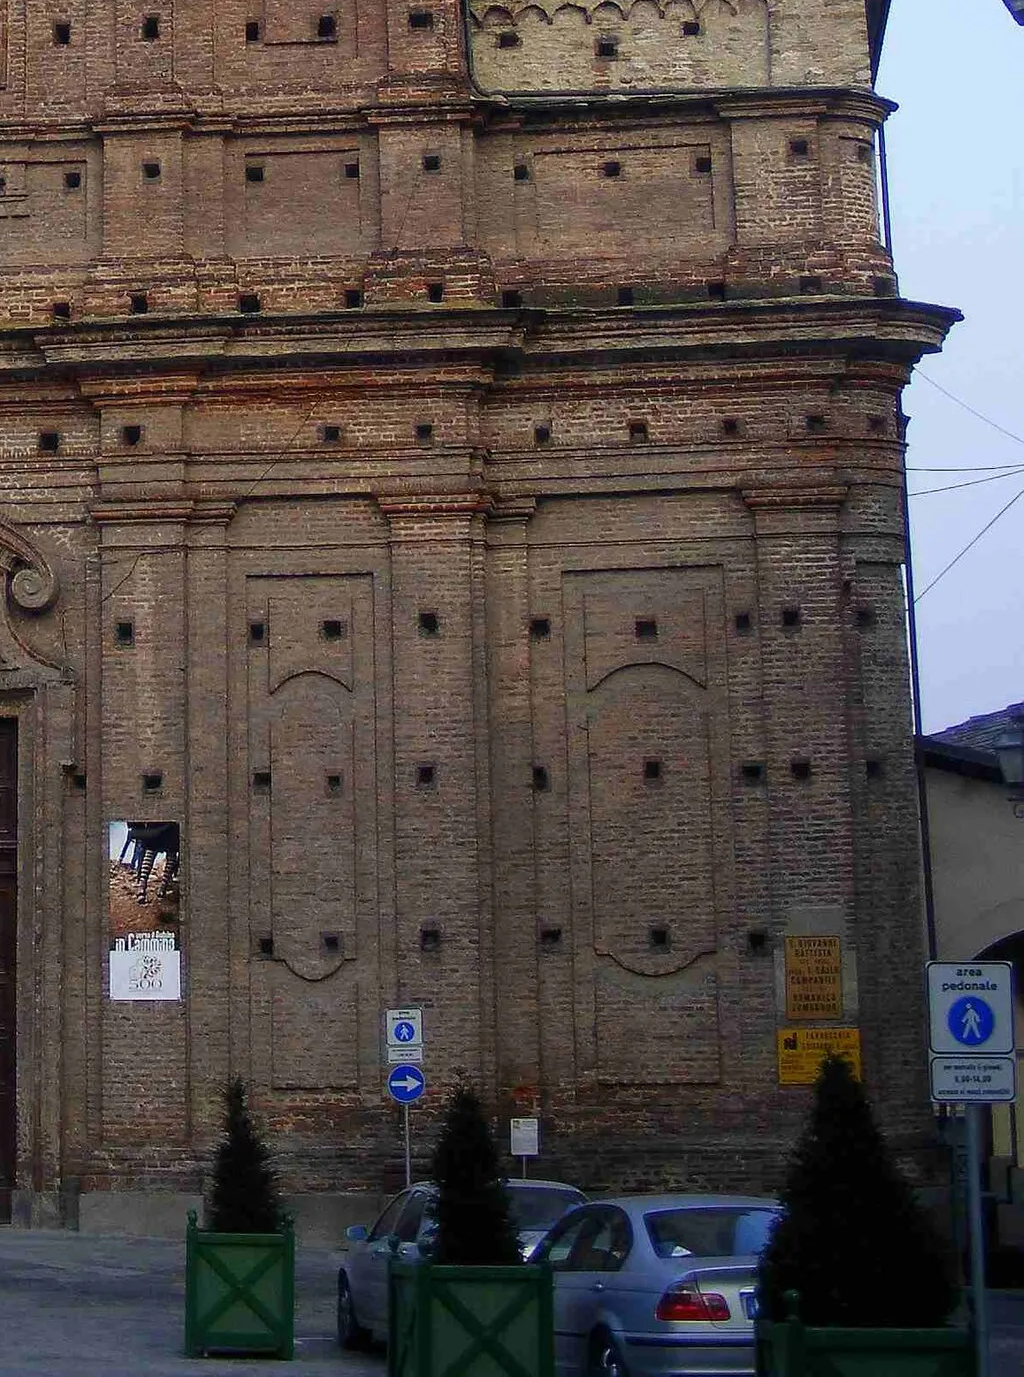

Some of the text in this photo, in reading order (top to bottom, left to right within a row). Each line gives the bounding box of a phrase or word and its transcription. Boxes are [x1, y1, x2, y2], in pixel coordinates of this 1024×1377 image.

[115, 937, 125, 952] in
[128, 933, 175, 952] Cammino
[955, 968, 982, 977] area
[128, 978, 163, 990] 500
[941, 980, 998, 993] pedonale
